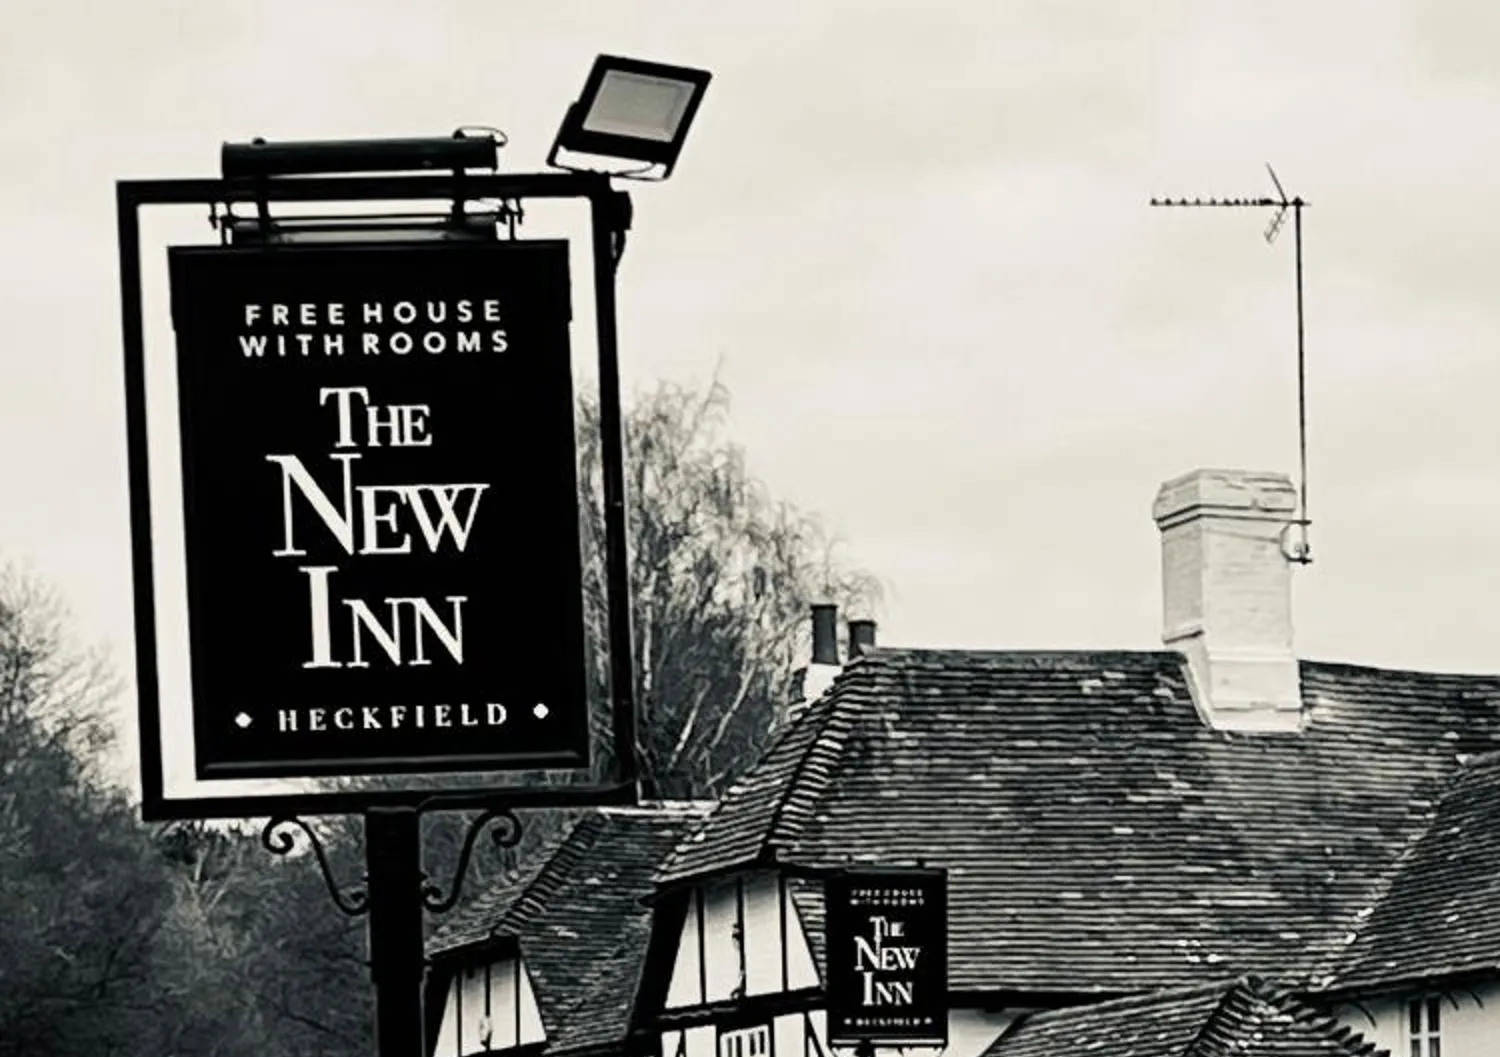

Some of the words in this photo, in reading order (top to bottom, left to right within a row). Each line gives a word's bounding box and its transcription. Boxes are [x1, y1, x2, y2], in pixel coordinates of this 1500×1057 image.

[245, 303, 345, 326] FREE
[363, 299, 501, 324] HOUSE
[239, 333, 344, 358] WITH
[362, 330, 508, 355] ROOMS
[319, 386, 433, 448] THE
[265, 452, 491, 557] NEW
[298, 565, 468, 669] INN
[278, 703, 507, 732] HECKFIELD
[853, 936, 921, 971] NEW
[862, 971, 913, 1006] INN
